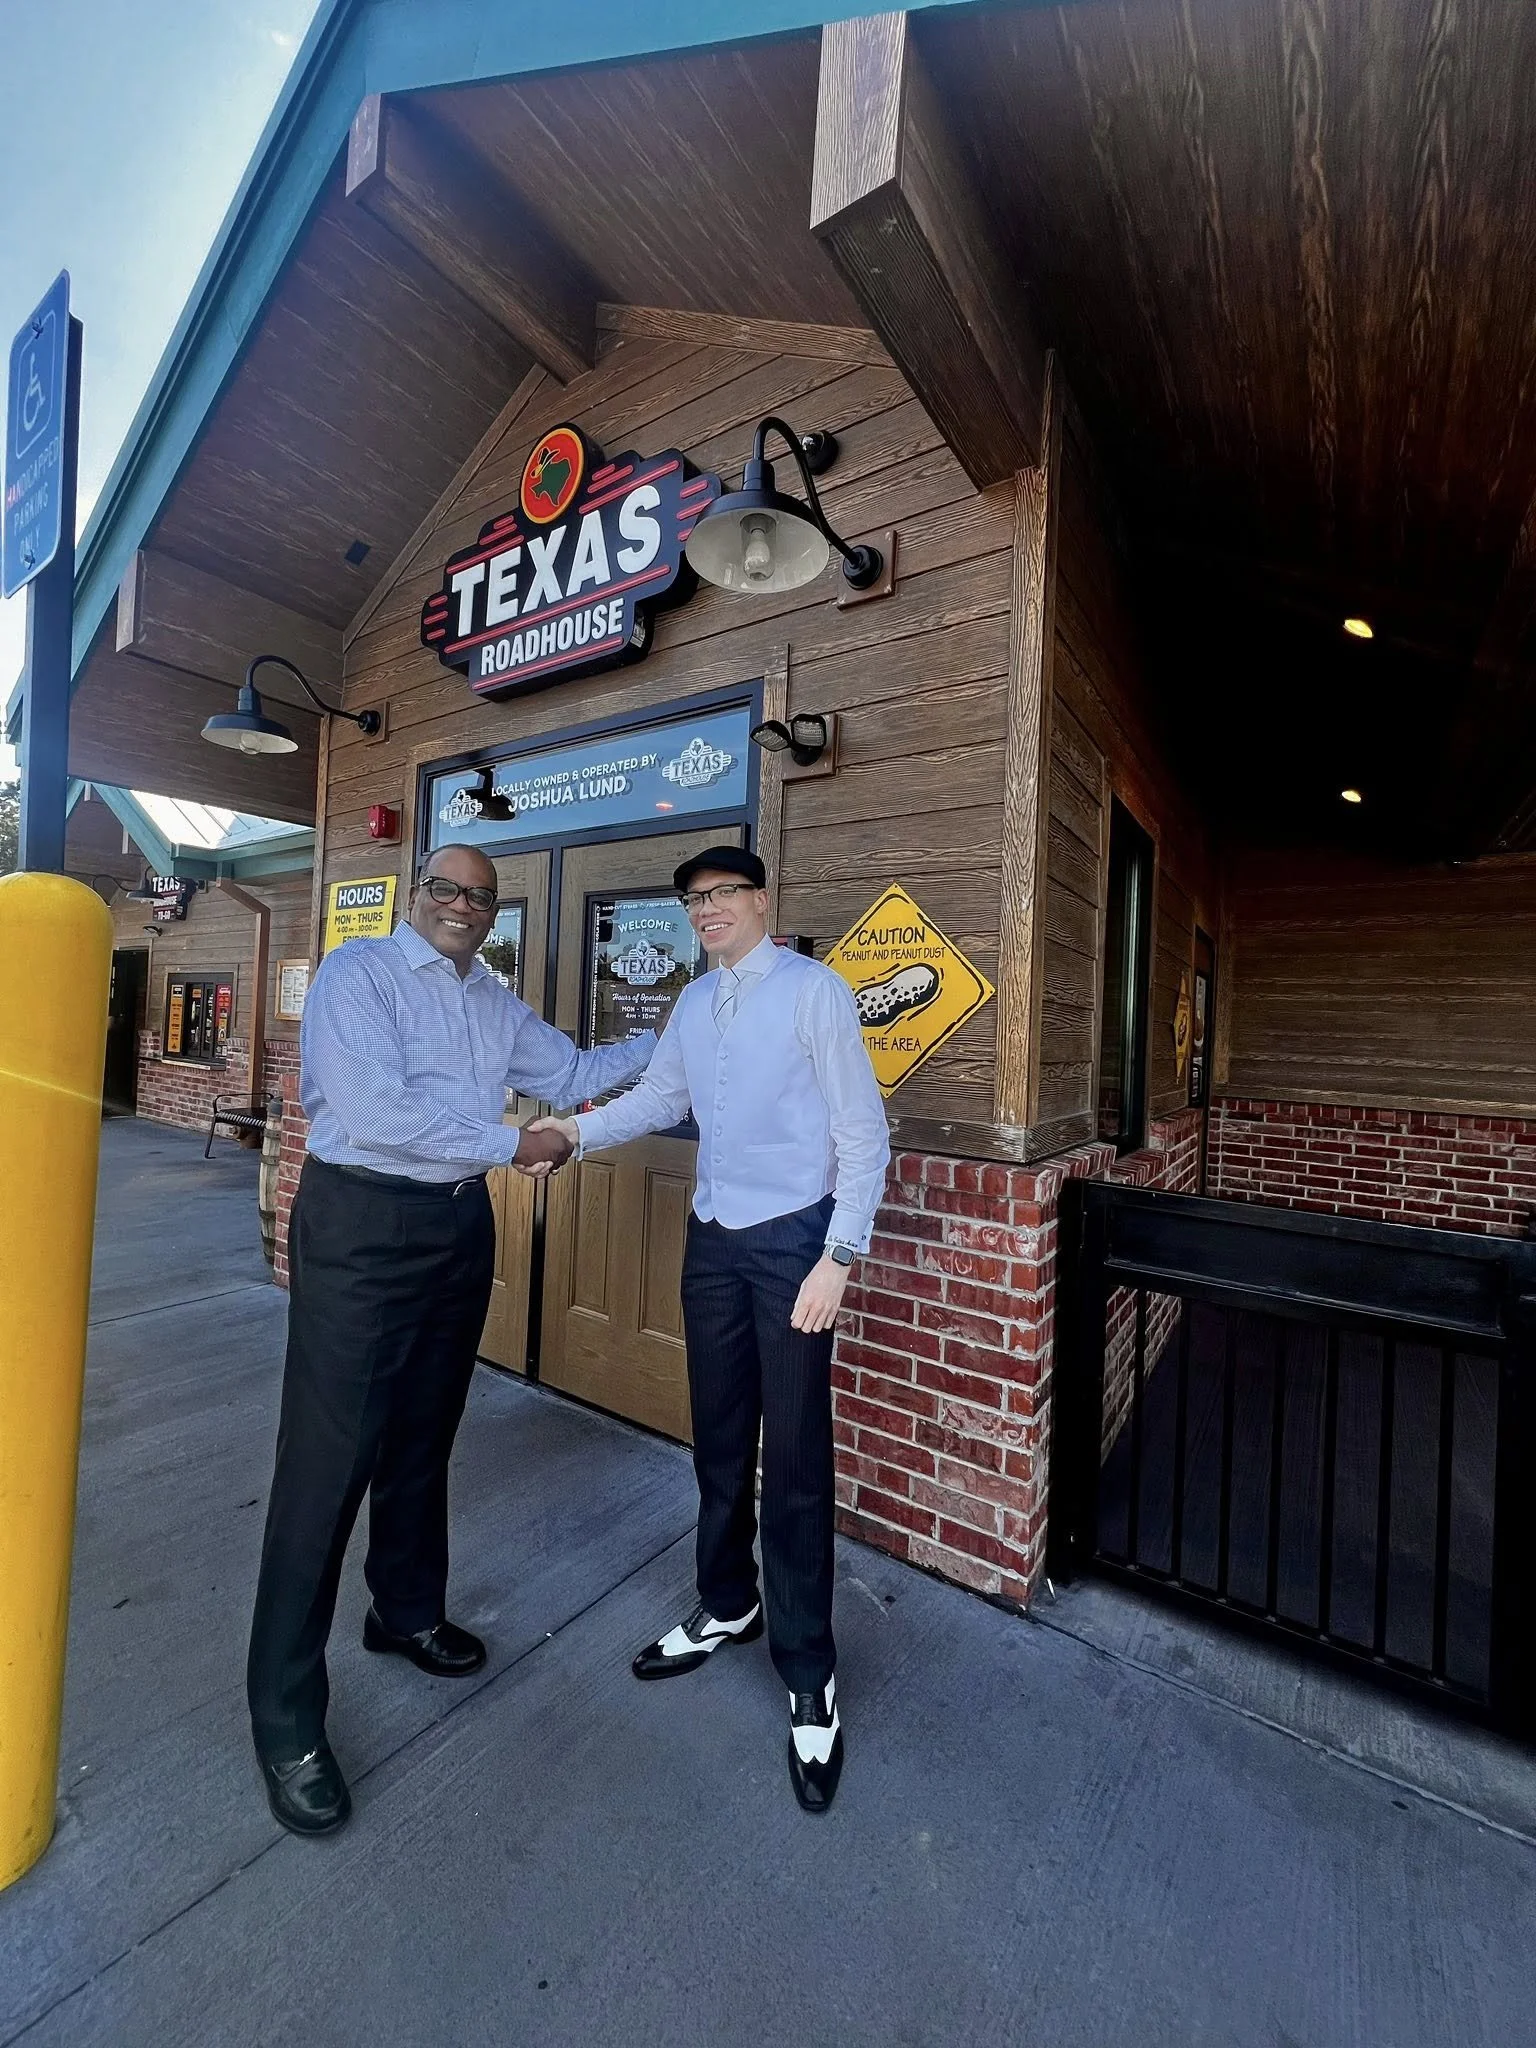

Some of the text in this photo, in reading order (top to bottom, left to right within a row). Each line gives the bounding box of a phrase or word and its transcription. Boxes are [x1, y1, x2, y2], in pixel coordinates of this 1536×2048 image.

[6, 437, 59, 512] HANDICAPPED
[14, 482, 49, 536] PARKING
[451, 485, 663, 637] TEXAS
[480, 598, 625, 676] ROADHOUSE
[491, 753, 658, 797] LOCALLY OWNED & OPERATED BY
[672, 754, 722, 778] TEXAS
[508, 775, 627, 813] JOSHUA LUND
[445, 802, 476, 820] TEXAS
[152, 876, 181, 893] TEXAS
[338, 885, 384, 906] HOURS
[334, 915, 351, 925] MON
[357, 912, 384, 923] THURS
[618, 919, 672, 933] WELCOME
[857, 926, 925, 947] CAUTION
[841, 946, 946, 962] PEANUT AND PEANUT DUST
[620, 957, 667, 975] TEXAS
[612, 992, 671, 1003] Hours of Operation
[868, 1037, 888, 1051] THE
[891, 1038, 922, 1052] AREA
